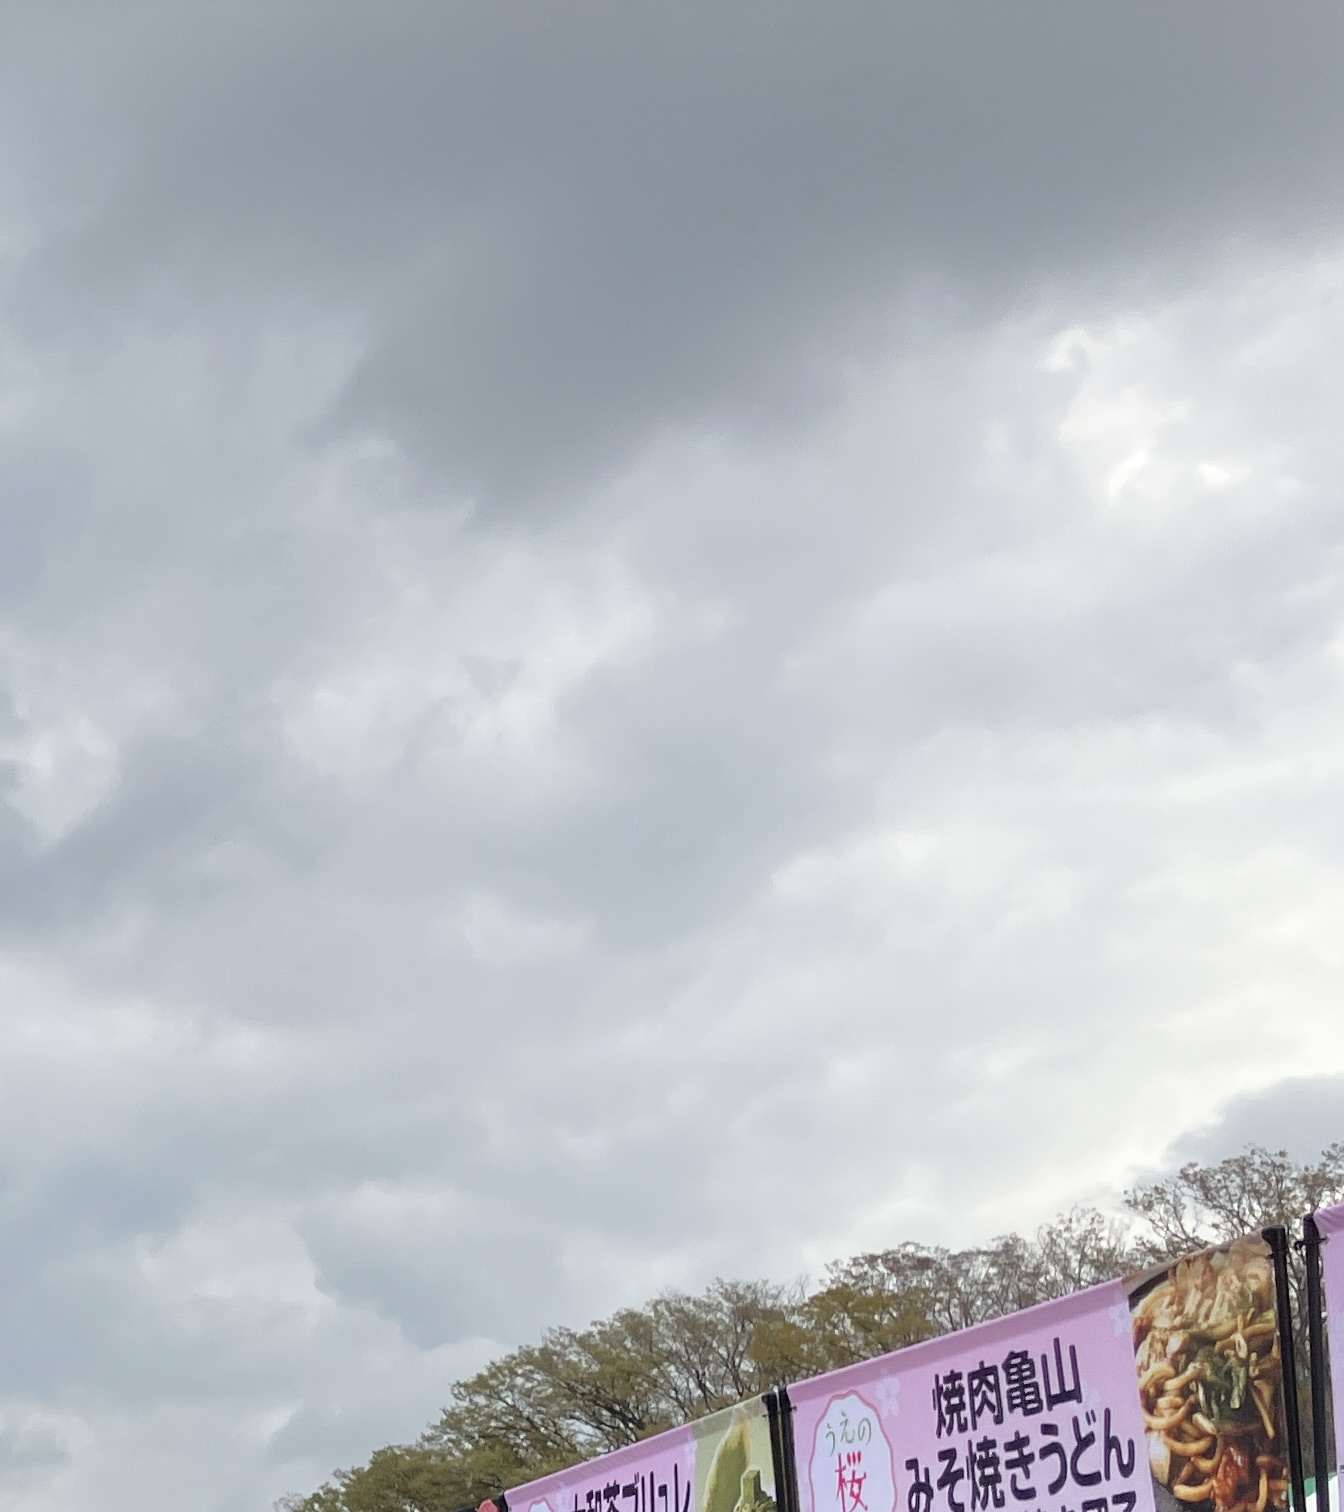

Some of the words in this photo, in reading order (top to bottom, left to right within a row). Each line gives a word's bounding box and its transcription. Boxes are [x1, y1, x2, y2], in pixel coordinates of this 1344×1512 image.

[931, 1337, 1083, 1440] 焼肉亀山
[823, 1410, 874, 1457] うえの
